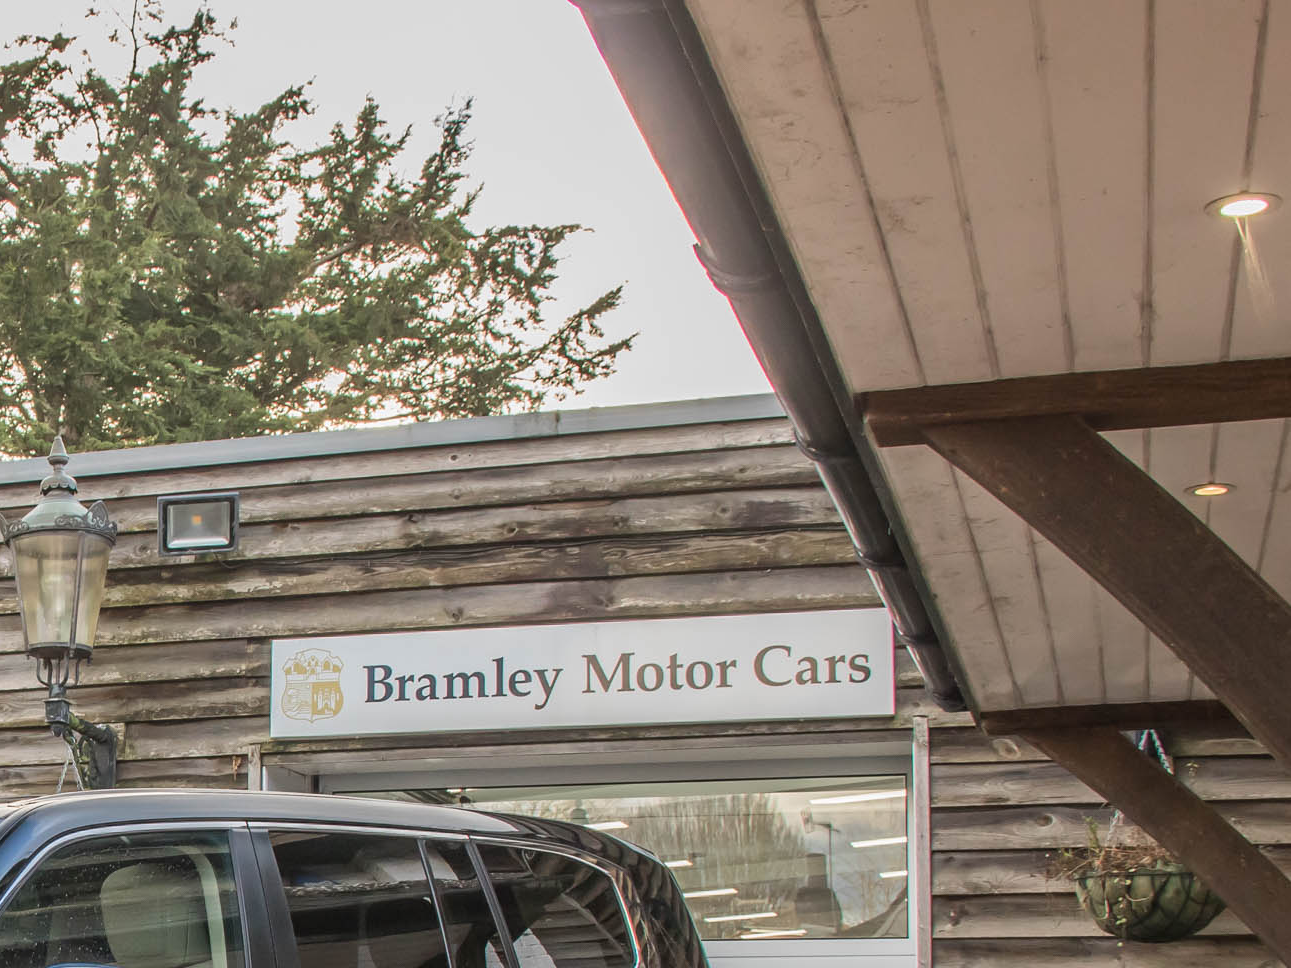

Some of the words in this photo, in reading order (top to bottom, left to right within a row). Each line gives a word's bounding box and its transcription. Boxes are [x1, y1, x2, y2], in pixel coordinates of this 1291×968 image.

[362, 657, 564, 710] Bramley
[582, 645, 738, 695] Motor
[753, 644, 872, 687] Cars
